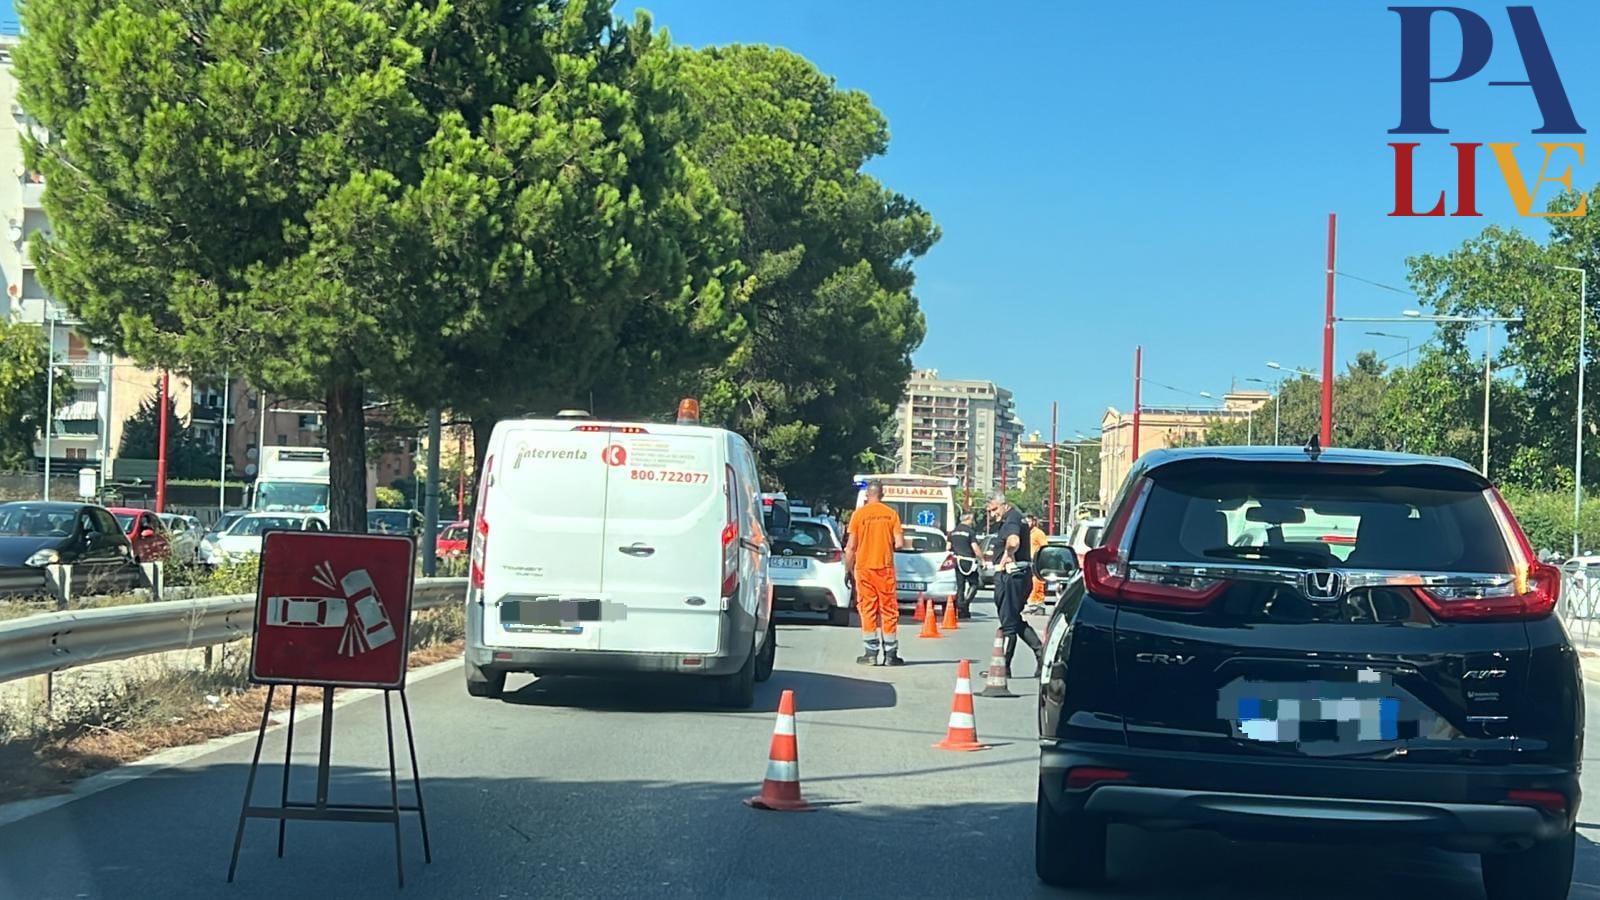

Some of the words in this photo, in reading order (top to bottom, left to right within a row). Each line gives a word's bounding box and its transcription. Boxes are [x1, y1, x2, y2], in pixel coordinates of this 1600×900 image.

[630, 469, 709, 484] 800.722077
[882, 487, 944, 496] BULANZA
[1136, 652, 1196, 665] CR-V
